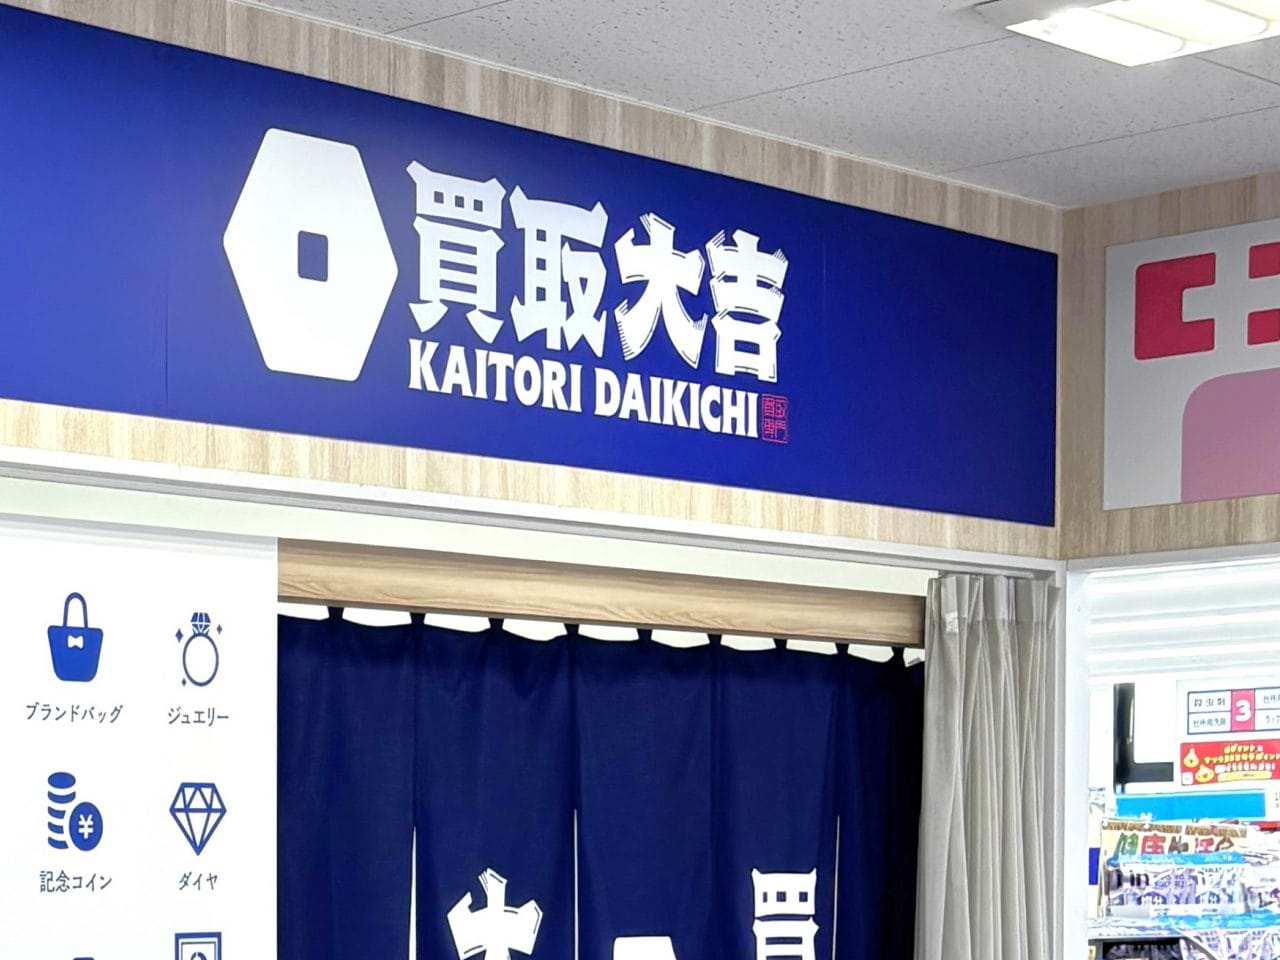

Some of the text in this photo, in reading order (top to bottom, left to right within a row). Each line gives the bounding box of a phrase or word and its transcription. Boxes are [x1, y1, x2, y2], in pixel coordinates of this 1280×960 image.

[406, 160, 788, 383] 買取大吉
[408, 339, 759, 439] KAITORI DAIKICHI
[25, 702, 123, 723] ブランドバッグ
[167, 706, 229, 726] ジュエリー
[1235, 700, 1252, 722] 3
[40, 870, 112, 893] 記念コイン
[178, 872, 219, 891] ダイヤ
